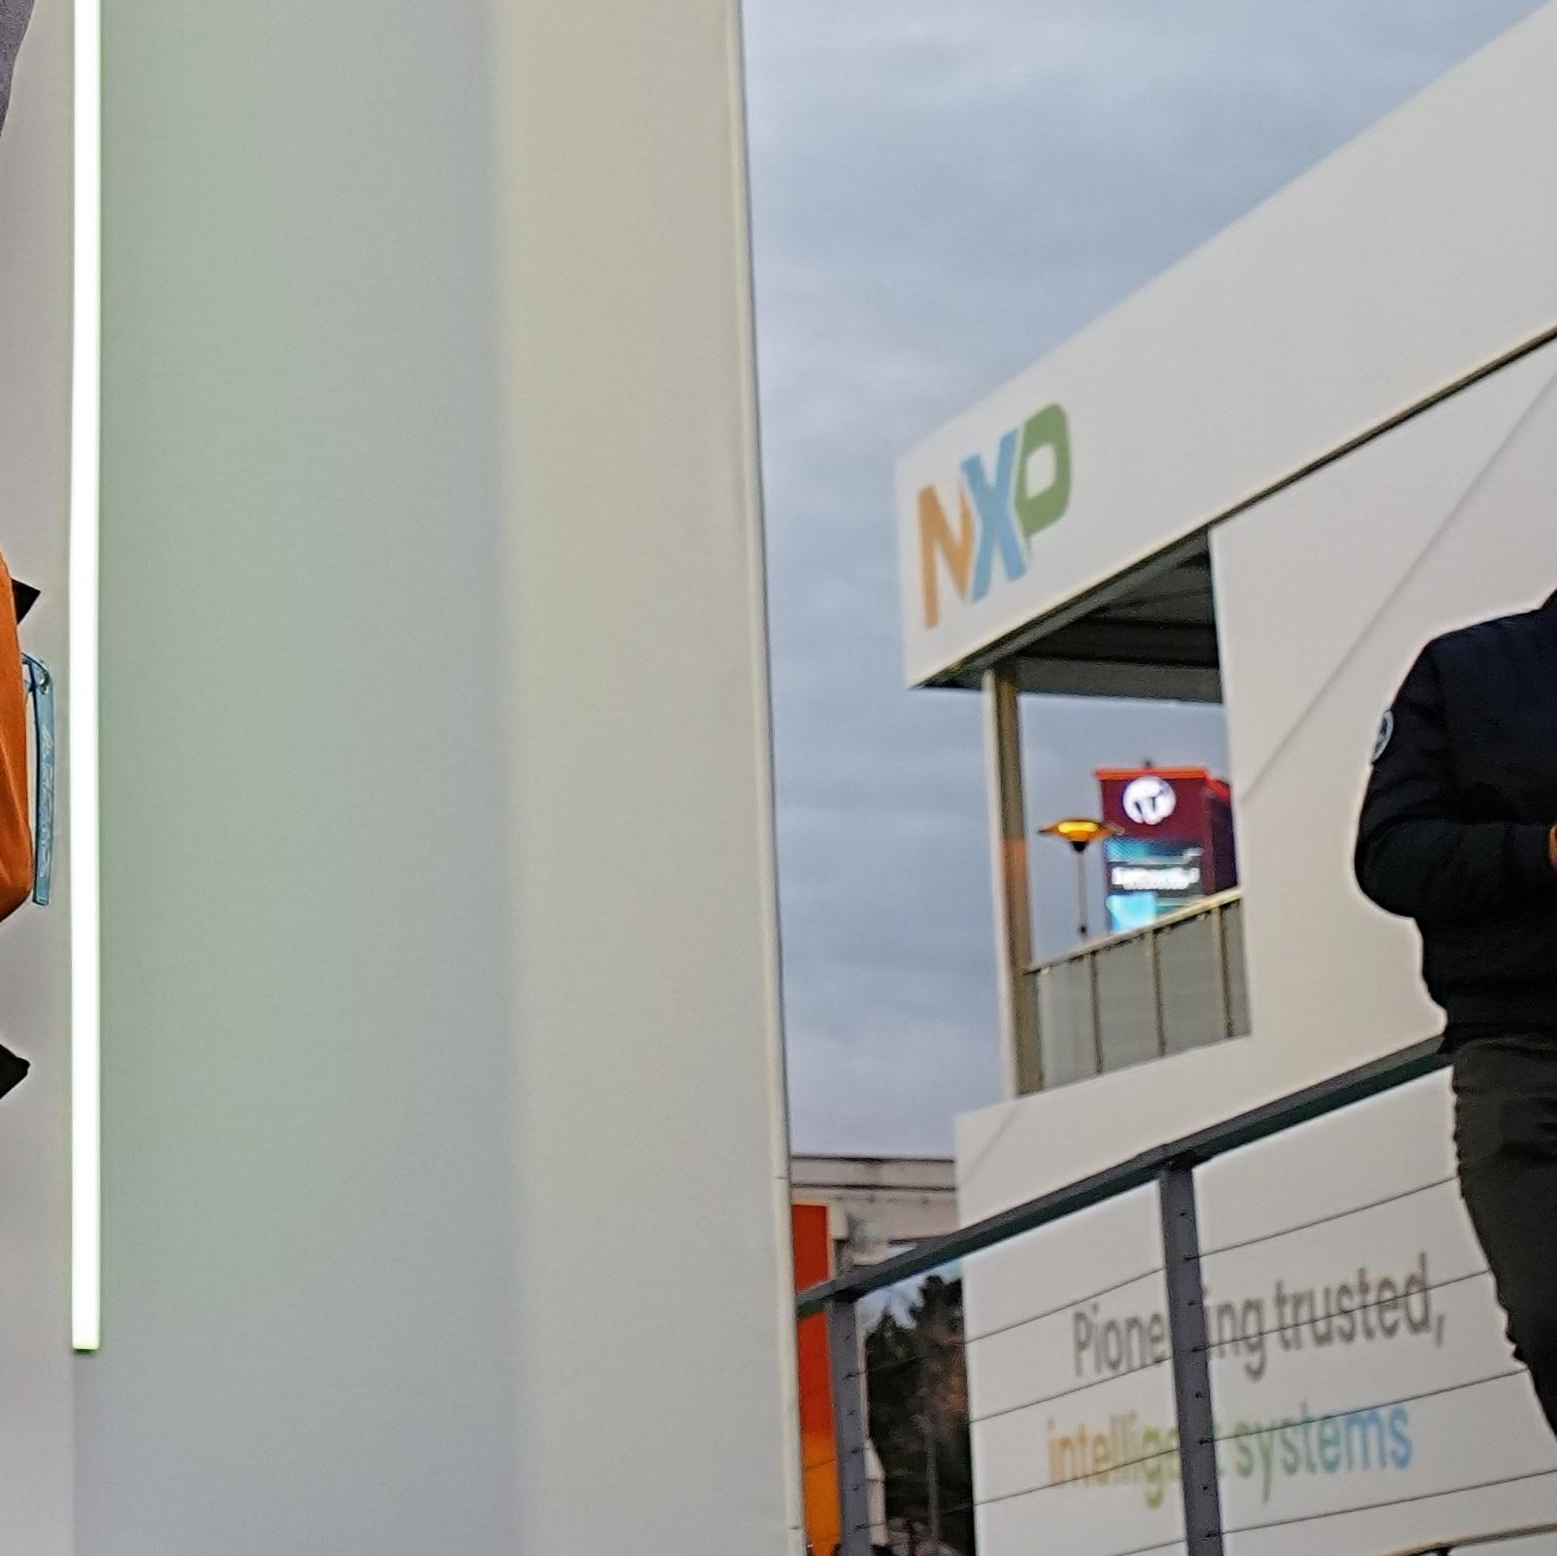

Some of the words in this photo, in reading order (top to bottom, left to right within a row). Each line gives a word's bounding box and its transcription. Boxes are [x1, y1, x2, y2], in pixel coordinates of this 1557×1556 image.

[917, 400, 1072, 630] NXP
[1071, 1294, 1268, 1384] Pioneing
[1273, 1249, 1446, 1348] trusted,
[1234, 1400, 1413, 1504] systems
